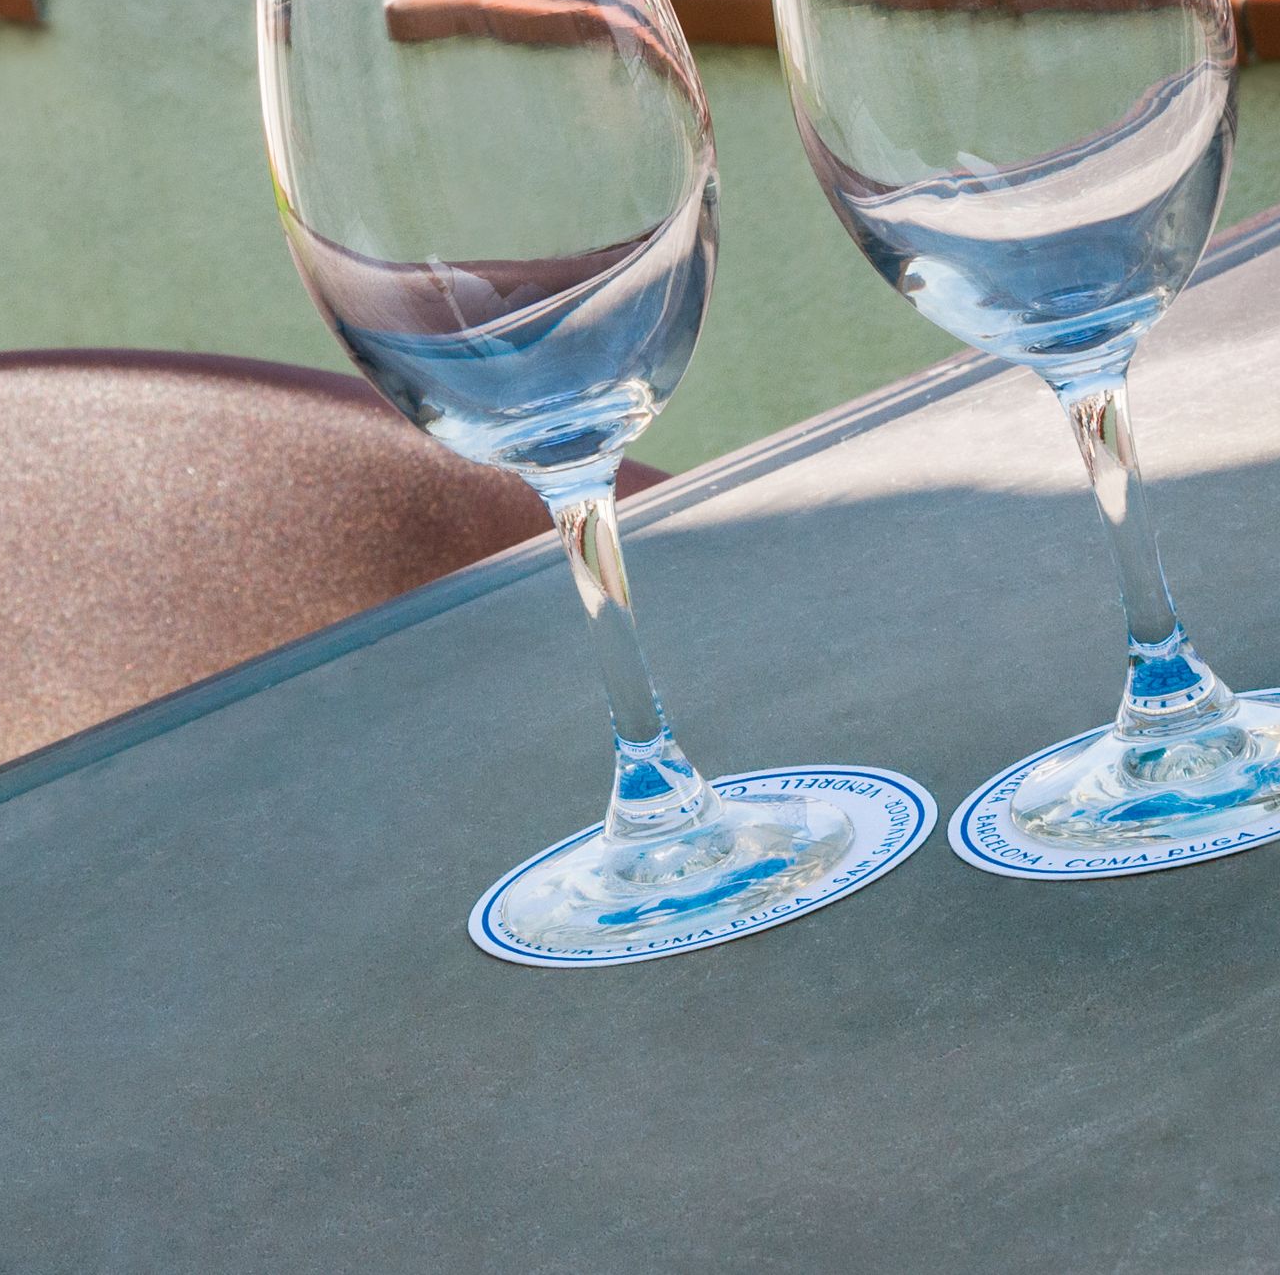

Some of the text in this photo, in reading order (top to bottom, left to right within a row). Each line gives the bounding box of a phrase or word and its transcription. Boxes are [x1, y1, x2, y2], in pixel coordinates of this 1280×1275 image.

[779, 778, 883, 799] VENDRELL
[871, 798, 912, 857] SALVADOR
[976, 813, 1044, 867] BARCELONA
